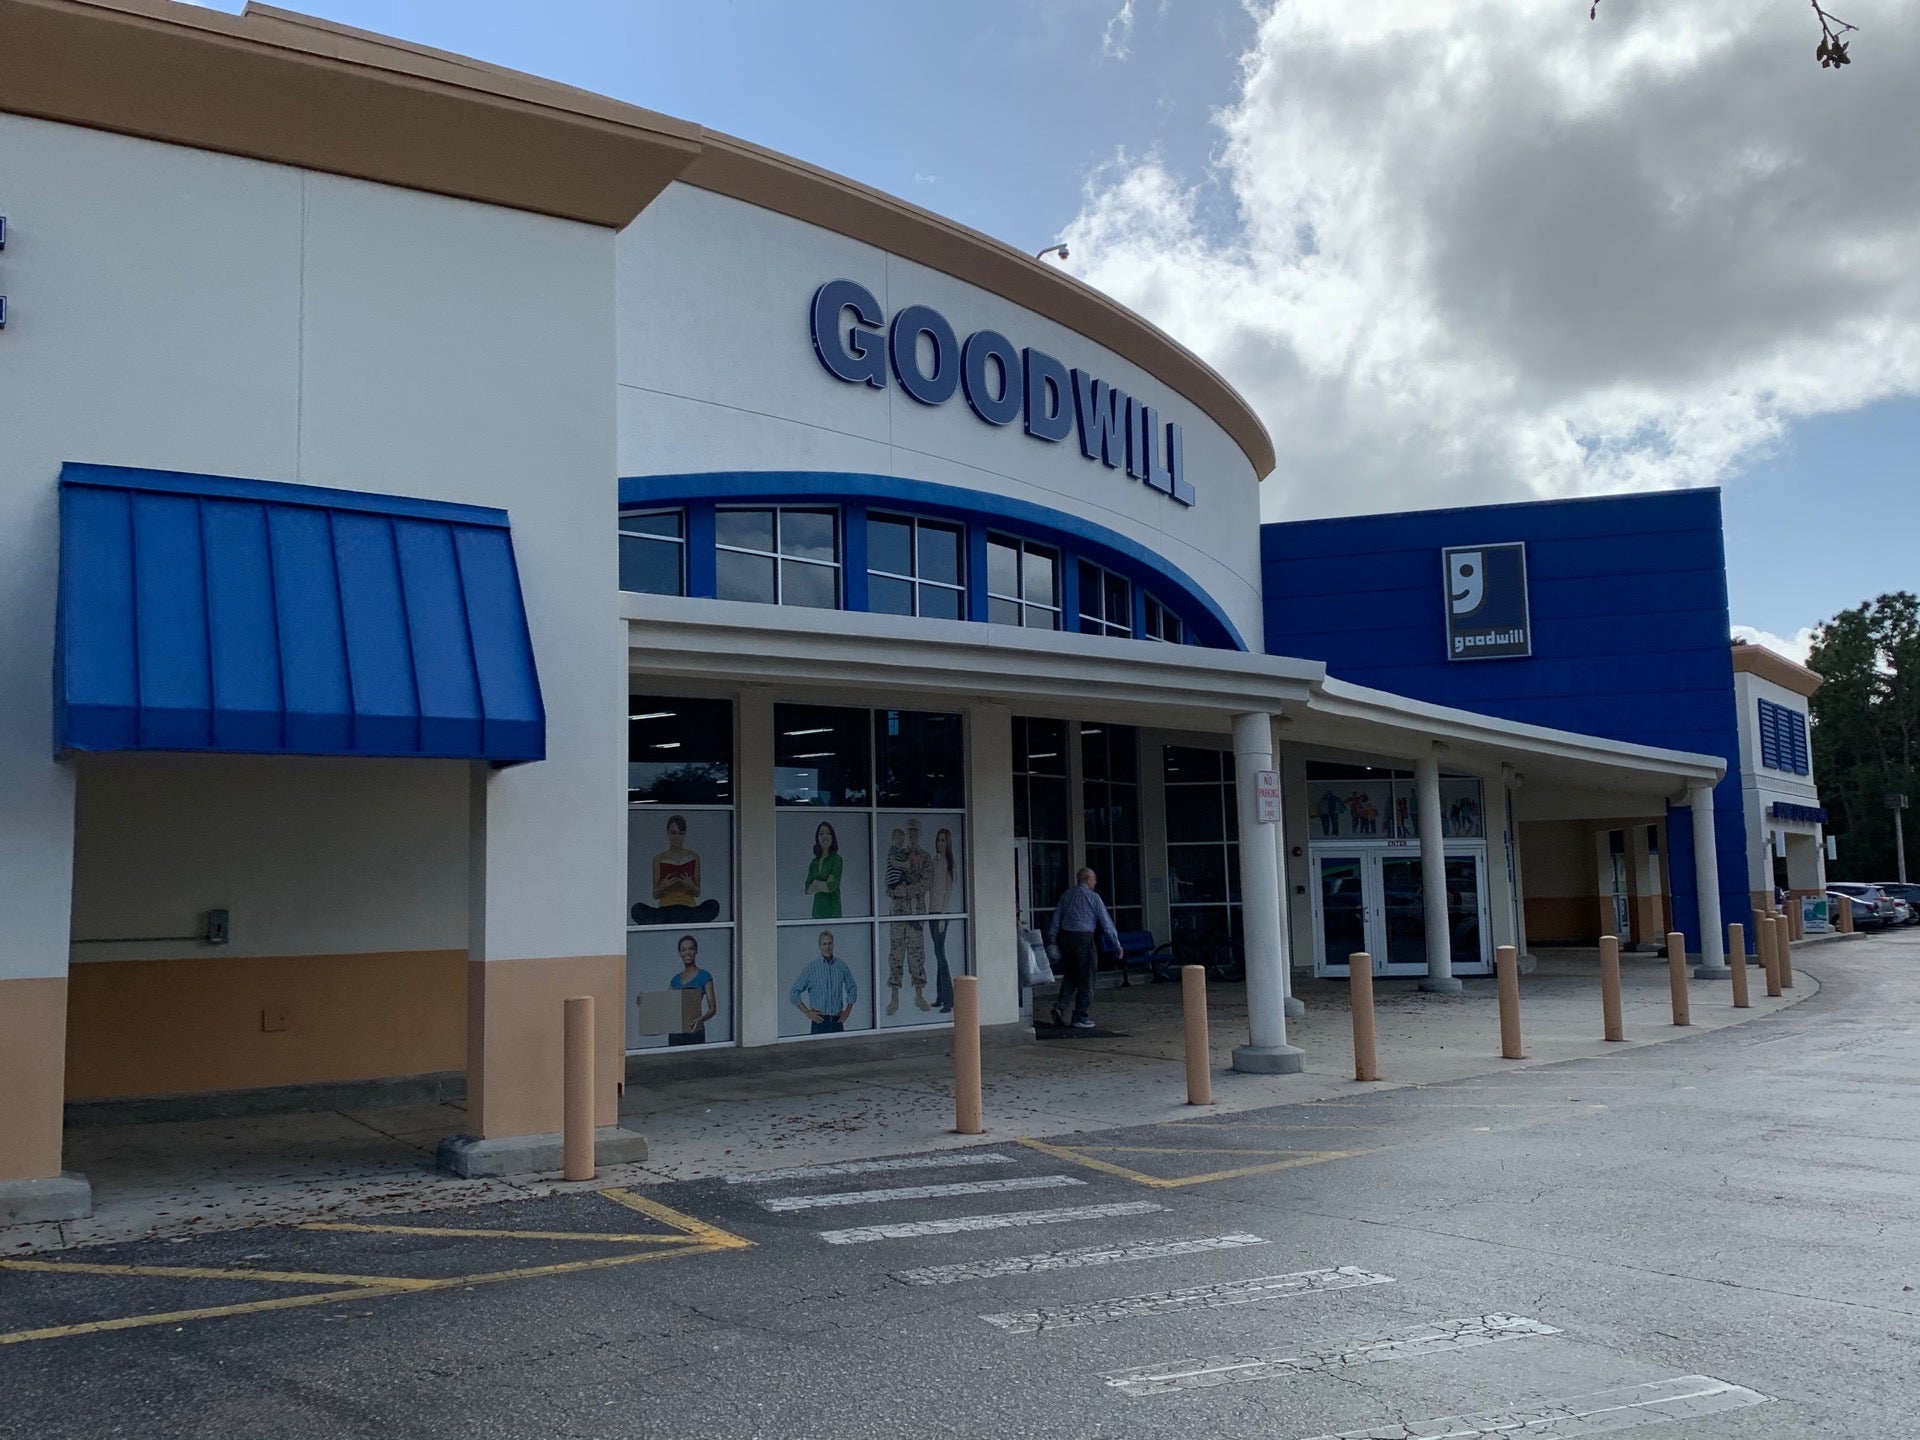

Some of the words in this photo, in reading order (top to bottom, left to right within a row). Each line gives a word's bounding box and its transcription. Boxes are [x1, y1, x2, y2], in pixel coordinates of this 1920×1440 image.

[810, 278, 1195, 507] GOODWILL
[1455, 629, 1524, 653] goodwill
[1263, 776, 1273, 786] NO
[1258, 788, 1279, 798] PARKING
